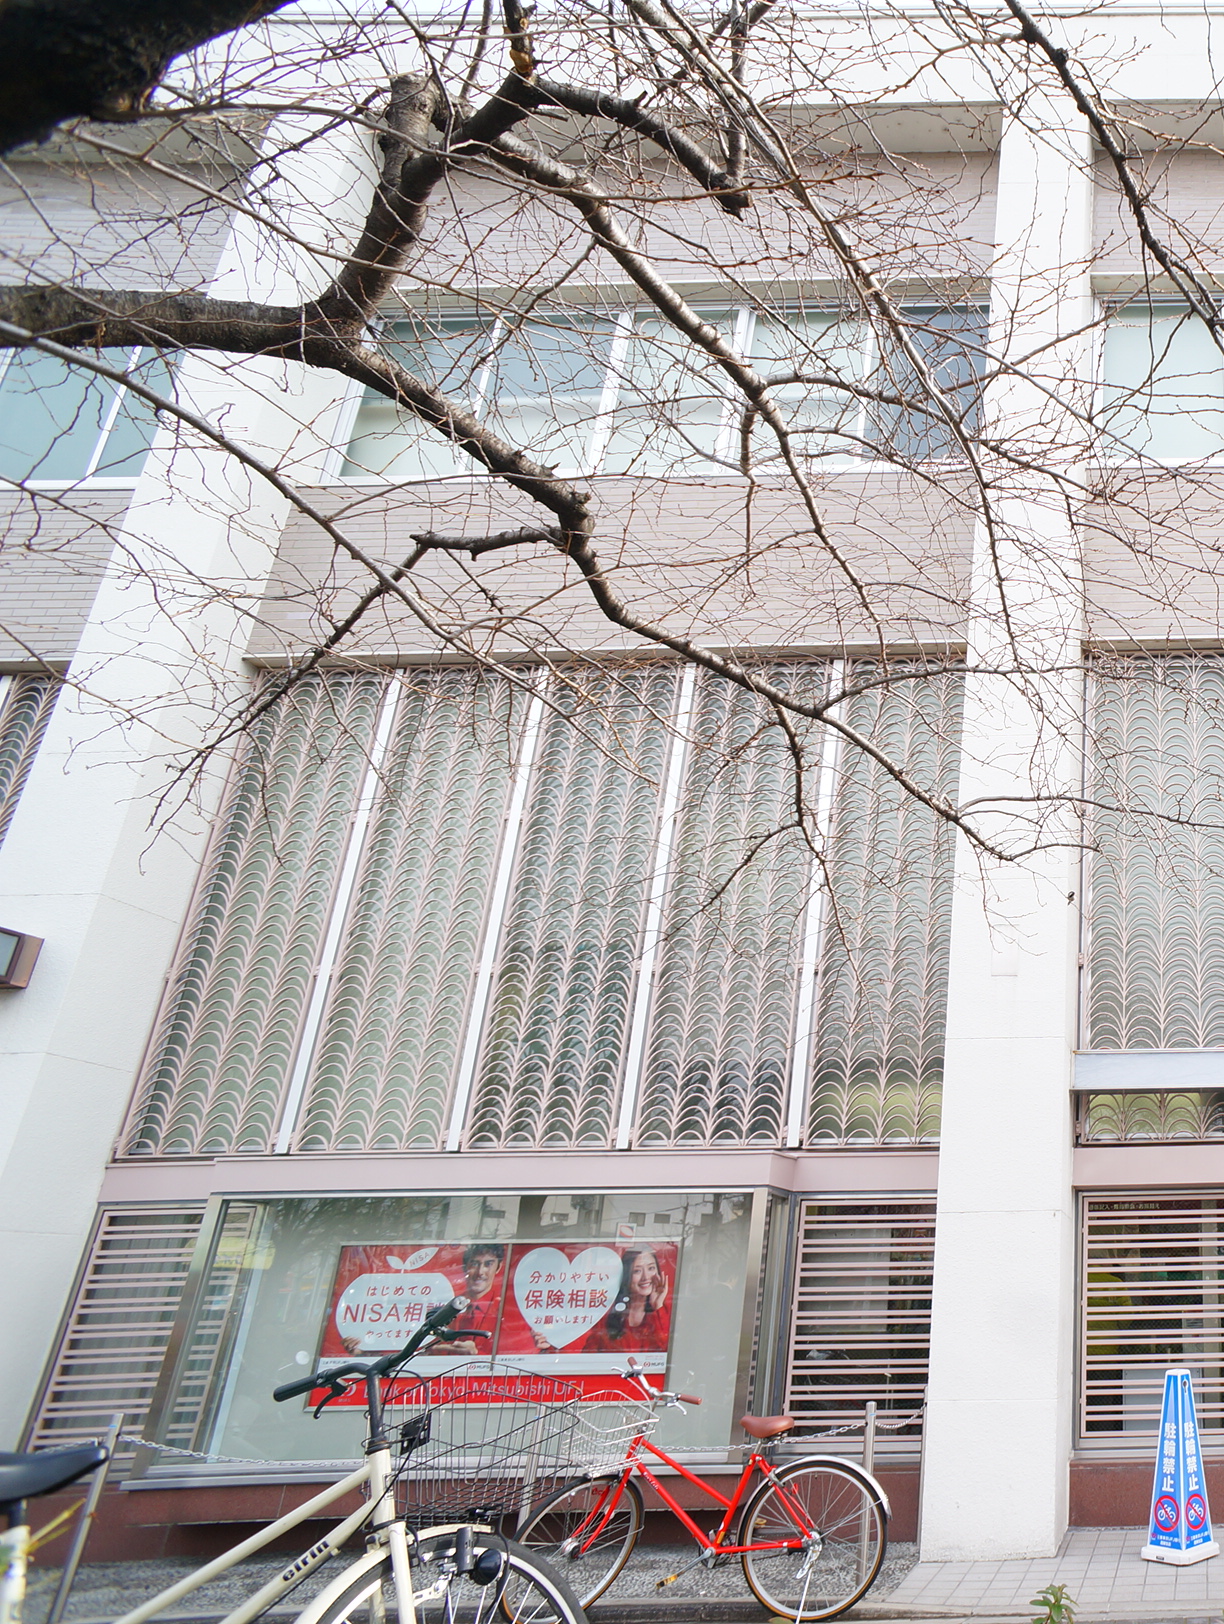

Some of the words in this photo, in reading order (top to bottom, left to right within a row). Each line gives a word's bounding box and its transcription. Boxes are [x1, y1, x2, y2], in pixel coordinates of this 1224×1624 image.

[409, 1251, 430, 1267] NISA
[529, 1270, 610, 1284] 分かりやすい
[366, 1285, 432, 1296] はじめての
[524, 1288, 609, 1309] 保険相談
[1162, 1422, 1177, 1492] 駐輪禁止
[1184, 1421, 1200, 1491] 駐輪禁止
